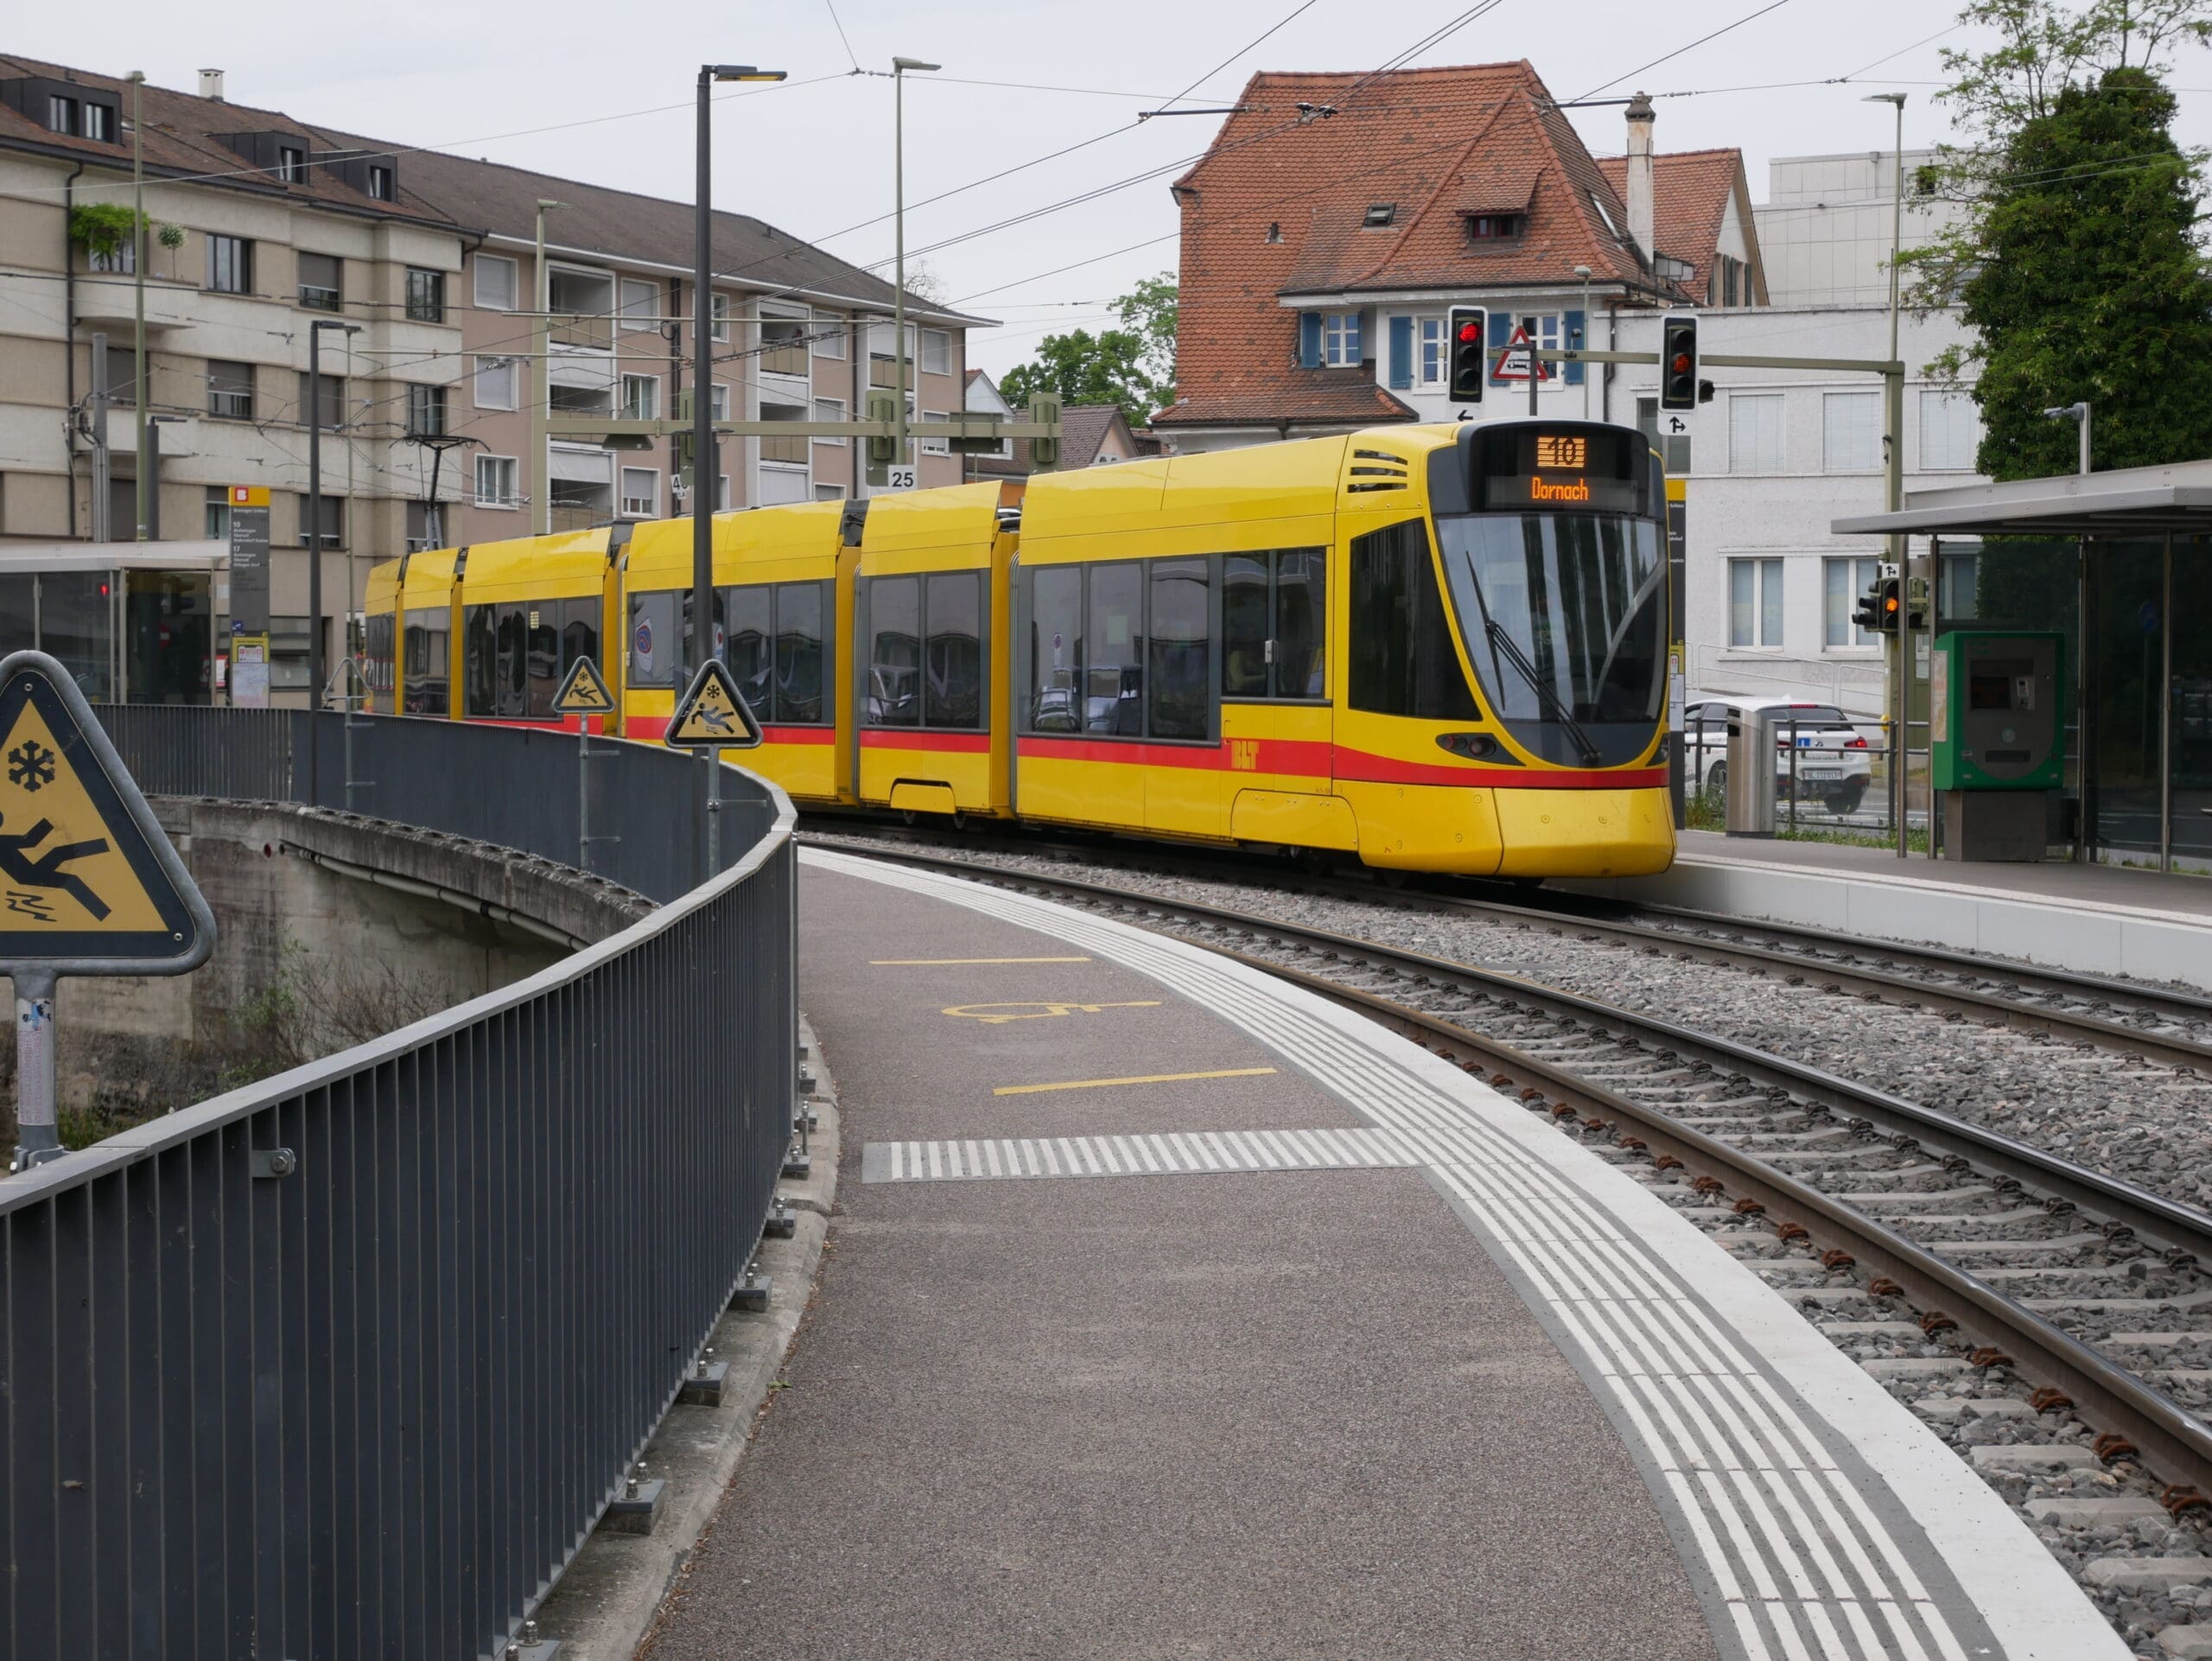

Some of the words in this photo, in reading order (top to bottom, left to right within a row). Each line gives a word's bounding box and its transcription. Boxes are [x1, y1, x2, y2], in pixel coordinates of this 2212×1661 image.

[892, 472, 913, 487] 25
[1532, 476, 1589, 500] Dornach
[1231, 741, 1260, 770] BLT
